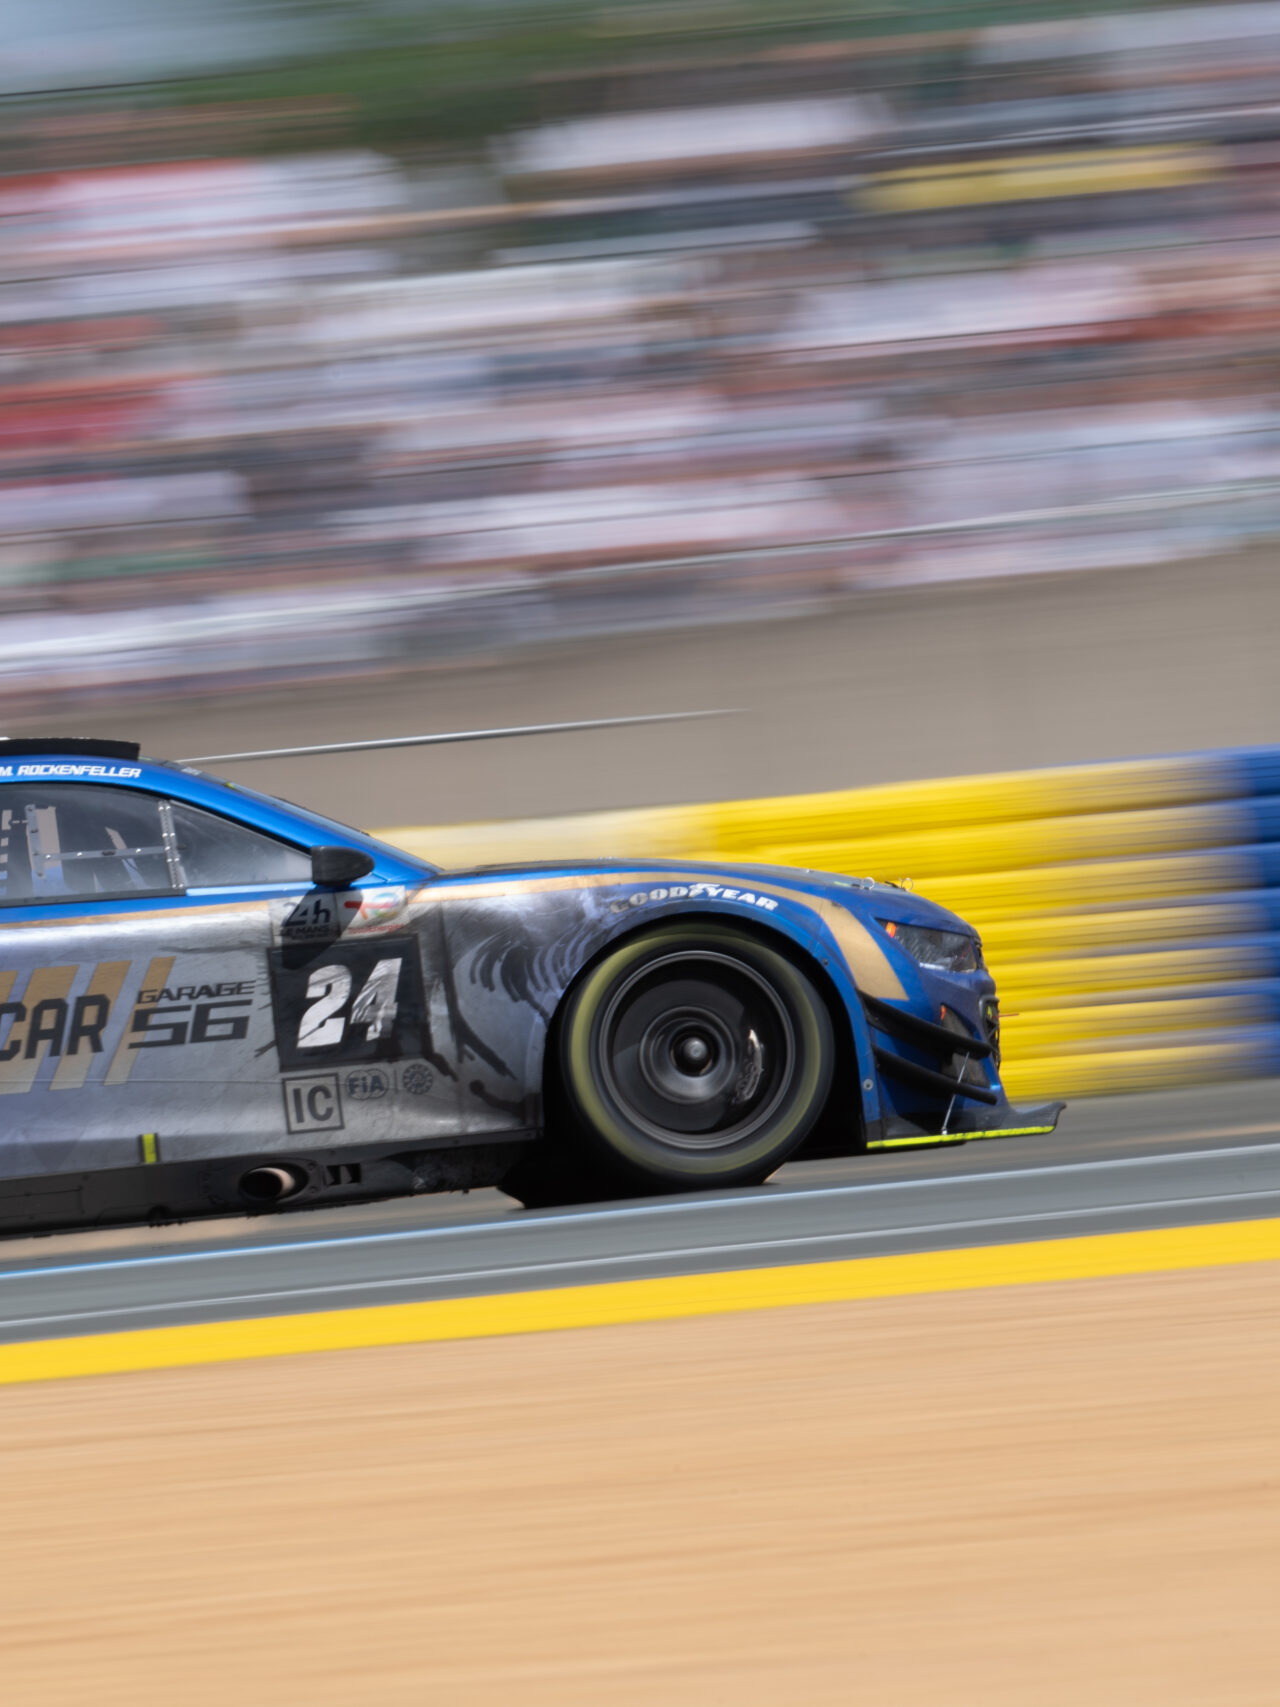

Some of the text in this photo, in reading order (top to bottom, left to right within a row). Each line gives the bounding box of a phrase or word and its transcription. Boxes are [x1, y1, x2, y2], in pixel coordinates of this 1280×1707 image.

[17, 764, 142, 779] ROCKENFELLER
[609, 882, 779, 913] GOODYEAR
[137, 980, 256, 1004] GARAGE
[297, 957, 403, 1049] 24
[128, 999, 253, 1050] 56
[292, 1085, 334, 1124] IC
